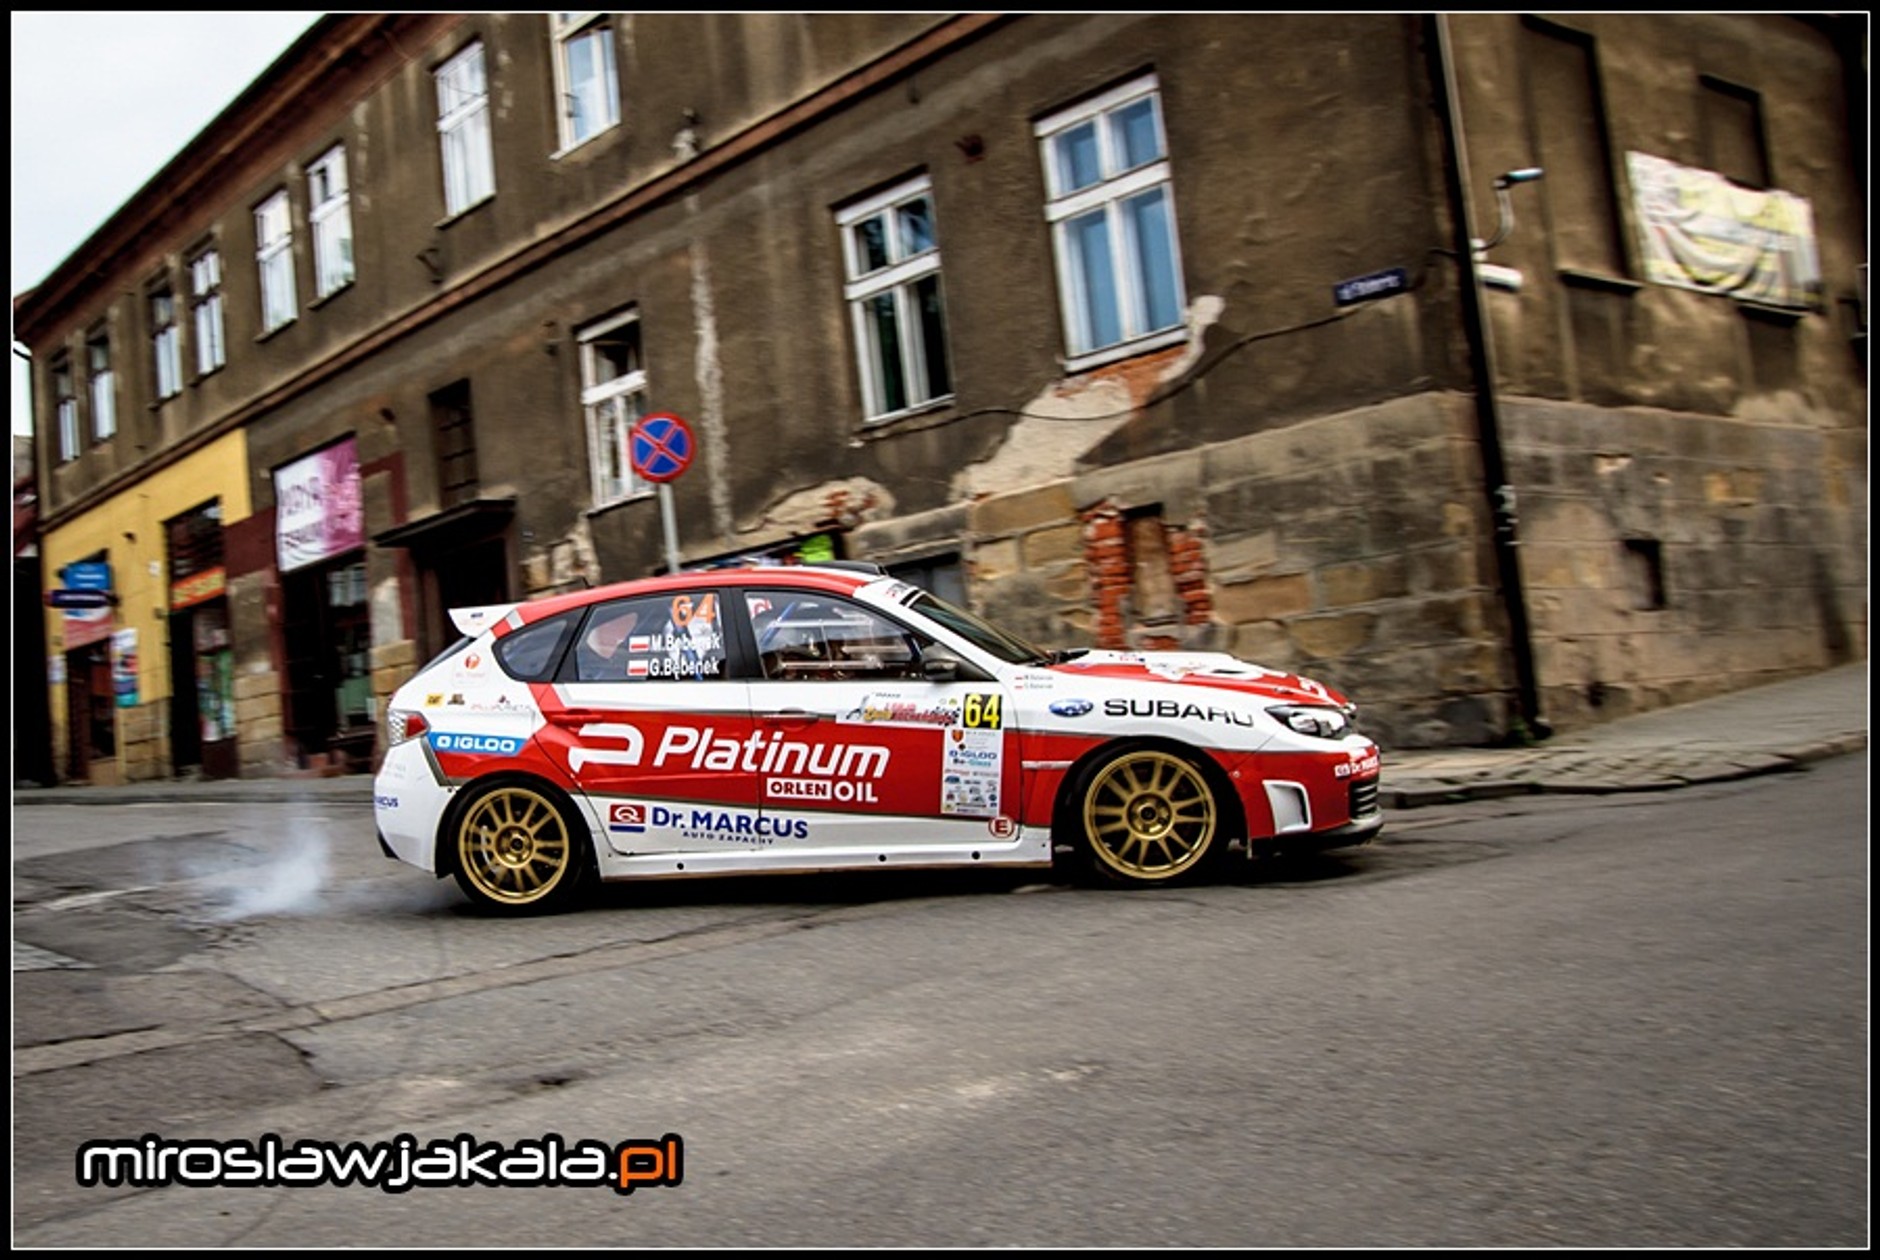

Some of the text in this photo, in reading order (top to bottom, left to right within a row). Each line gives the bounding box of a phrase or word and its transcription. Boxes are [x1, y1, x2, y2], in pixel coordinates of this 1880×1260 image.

[672, 593, 716, 627] 64
[965, 694, 1000, 729] 64
[1104, 699, 1255, 728] SUBARU
[454, 736, 516, 752] IGLOO
[653, 726, 891, 778] Platinum
[771, 781, 879, 803] ORLEN OIL
[682, 831, 715, 840] AUTO
[994, 819, 1009, 834] E
